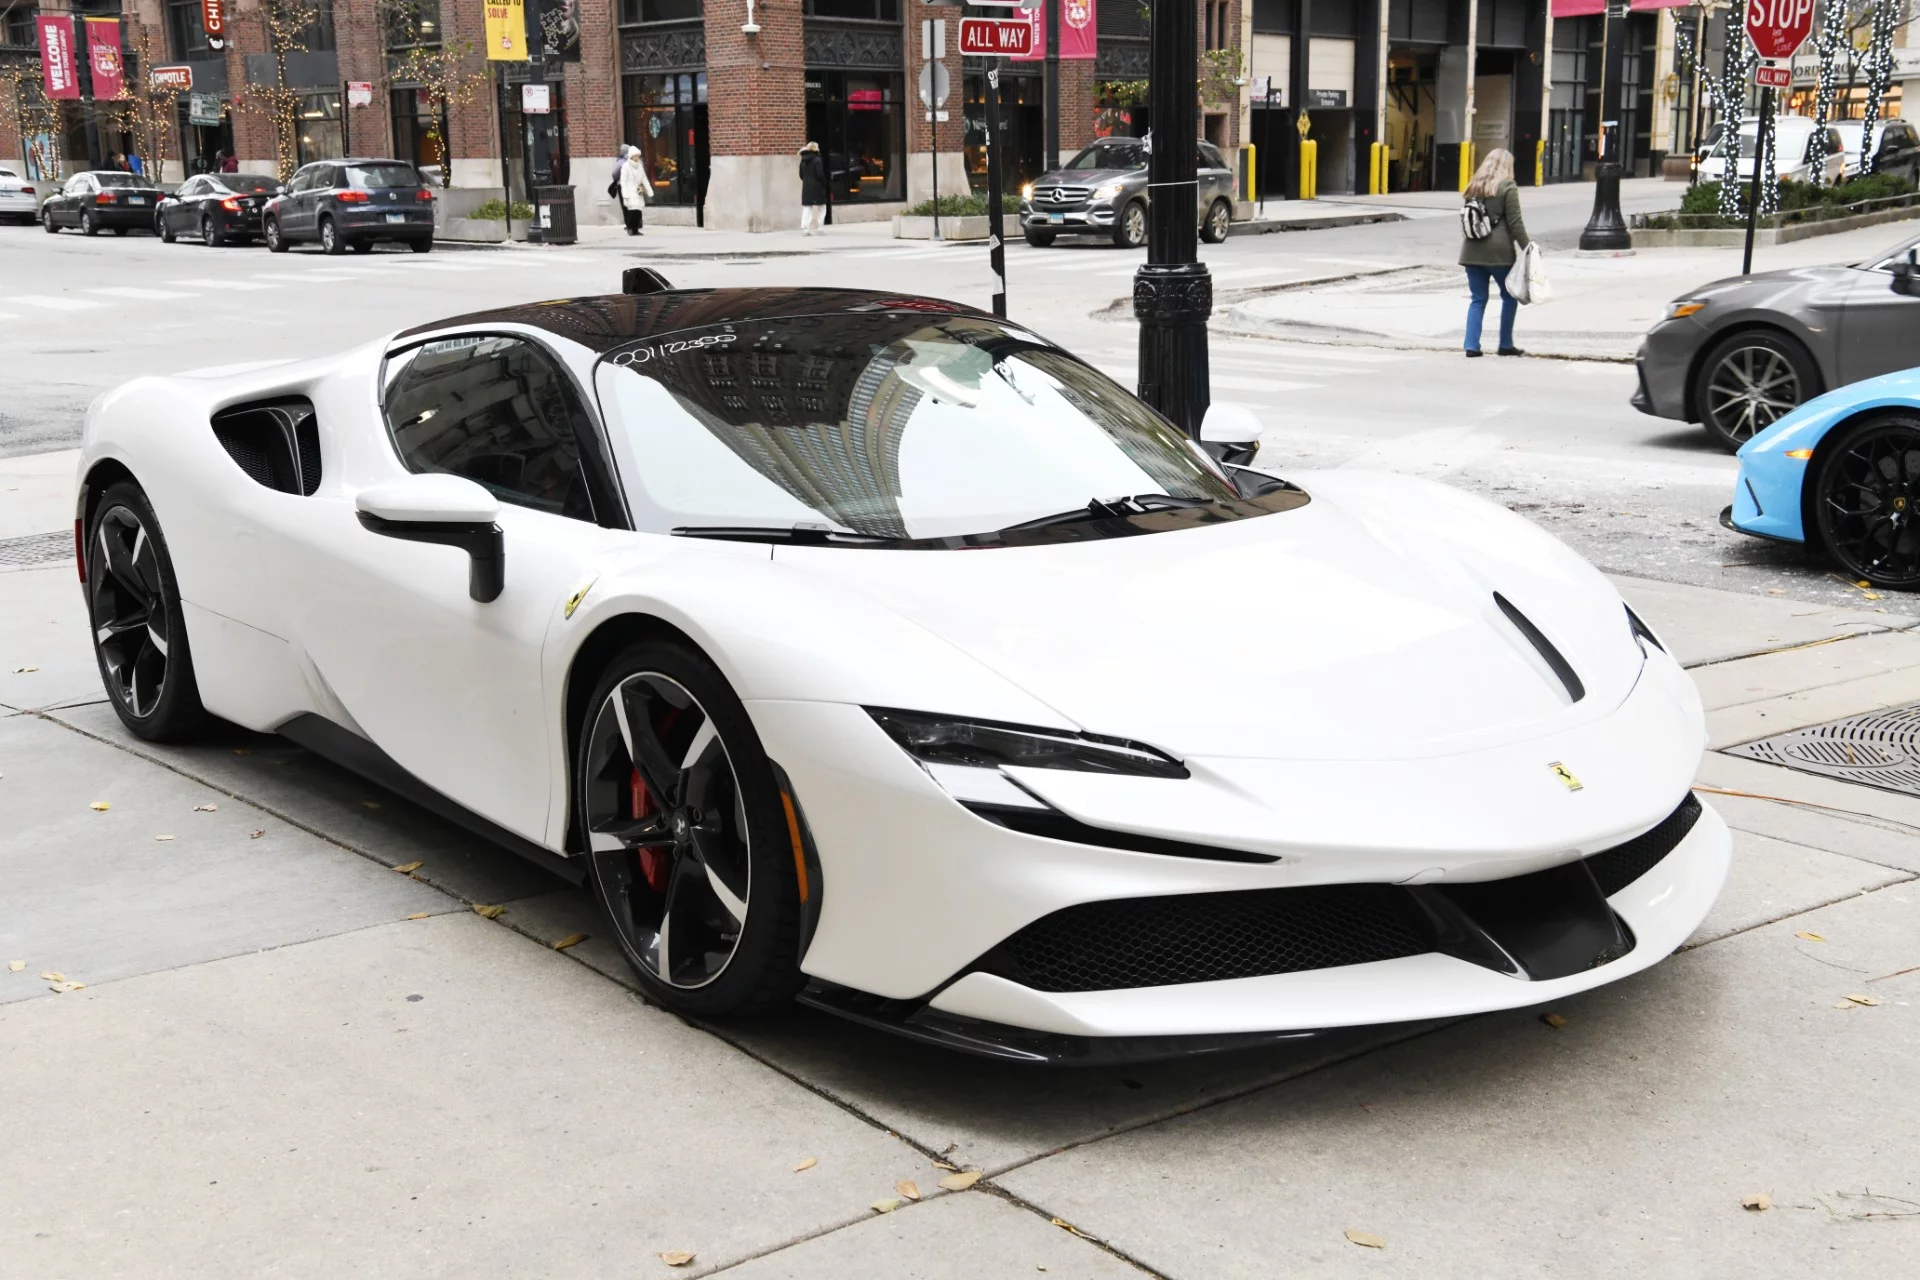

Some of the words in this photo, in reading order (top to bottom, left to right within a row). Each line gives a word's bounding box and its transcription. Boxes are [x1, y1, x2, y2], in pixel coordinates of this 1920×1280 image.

[488, 8, 508, 18] SOLVE
[1750, 0, 1811, 29] STOP
[967, 26, 993, 47] ALL
[999, 27, 1026, 48] WAY
[44, 25, 65, 91] WELCOME
[1759, 70, 1772, 82] ALL
[1774, 72, 1788, 83] WAY
